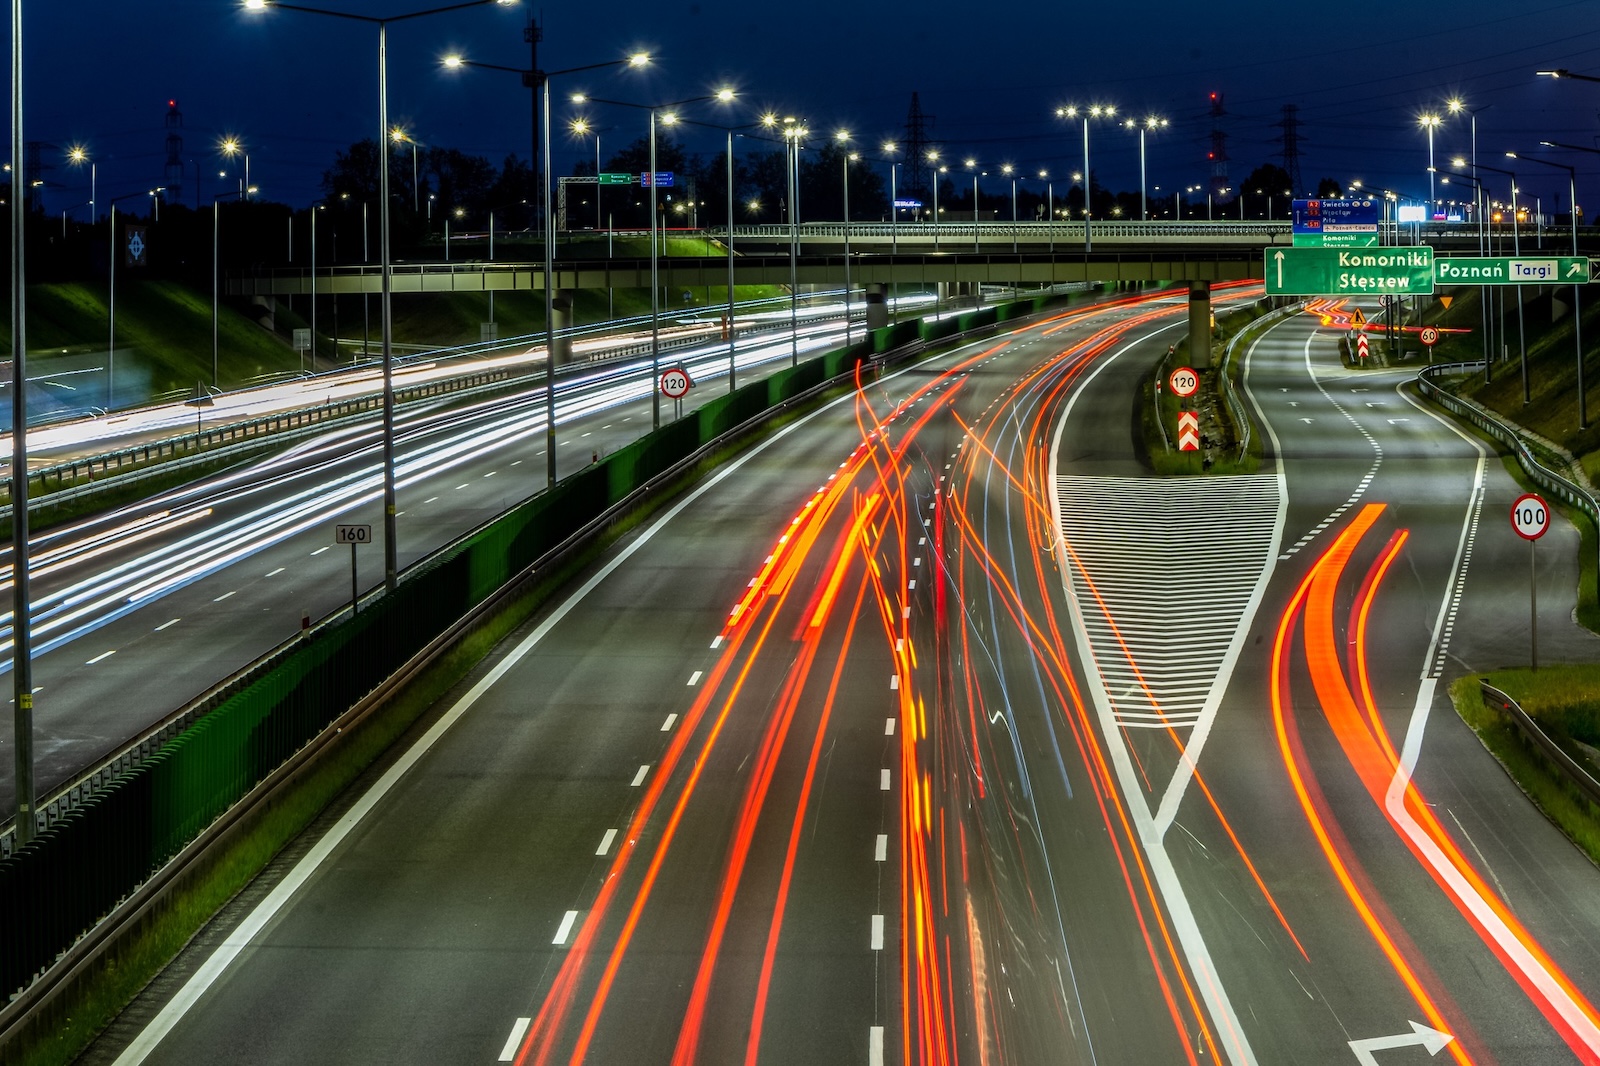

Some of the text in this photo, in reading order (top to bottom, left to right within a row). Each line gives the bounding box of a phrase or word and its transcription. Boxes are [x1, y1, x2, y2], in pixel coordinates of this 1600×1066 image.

[1322, 200, 1350, 208] Świecko
[1339, 252, 1428, 267] Komorniki
[1440, 262, 1551, 279] Poznań Targi
[1340, 273, 1410, 292] Stęszew
[1423, 331, 1435, 341] 60
[664, 378, 685, 389] 120
[1174, 377, 1195, 388] 120
[1515, 508, 1545, 526] 100
[341, 527, 366, 541] 160
